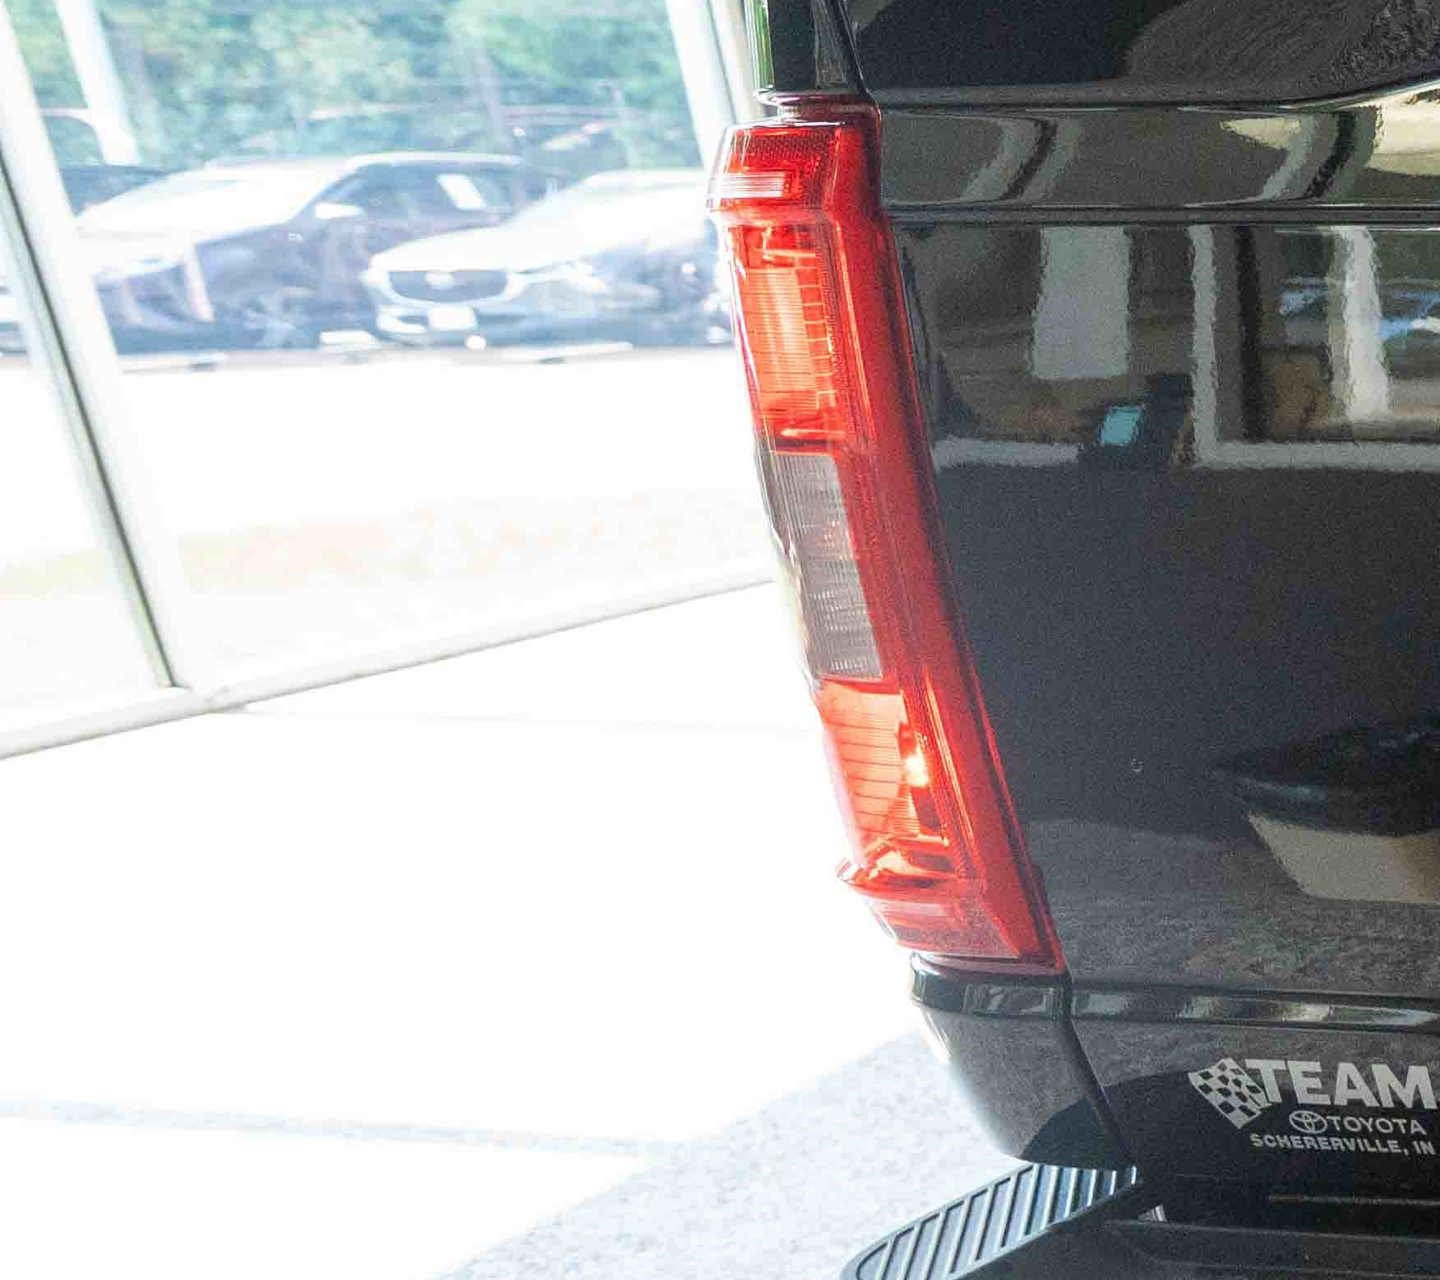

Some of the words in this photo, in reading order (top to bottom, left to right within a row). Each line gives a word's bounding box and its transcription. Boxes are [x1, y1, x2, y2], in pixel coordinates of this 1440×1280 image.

[1244, 1057, 1438, 1110] TEAM
[1325, 1115, 1428, 1136] TOYOTA
[1249, 1132, 1410, 1156] SCHERERVILLE,
[1412, 1140, 1437, 1156] IN
